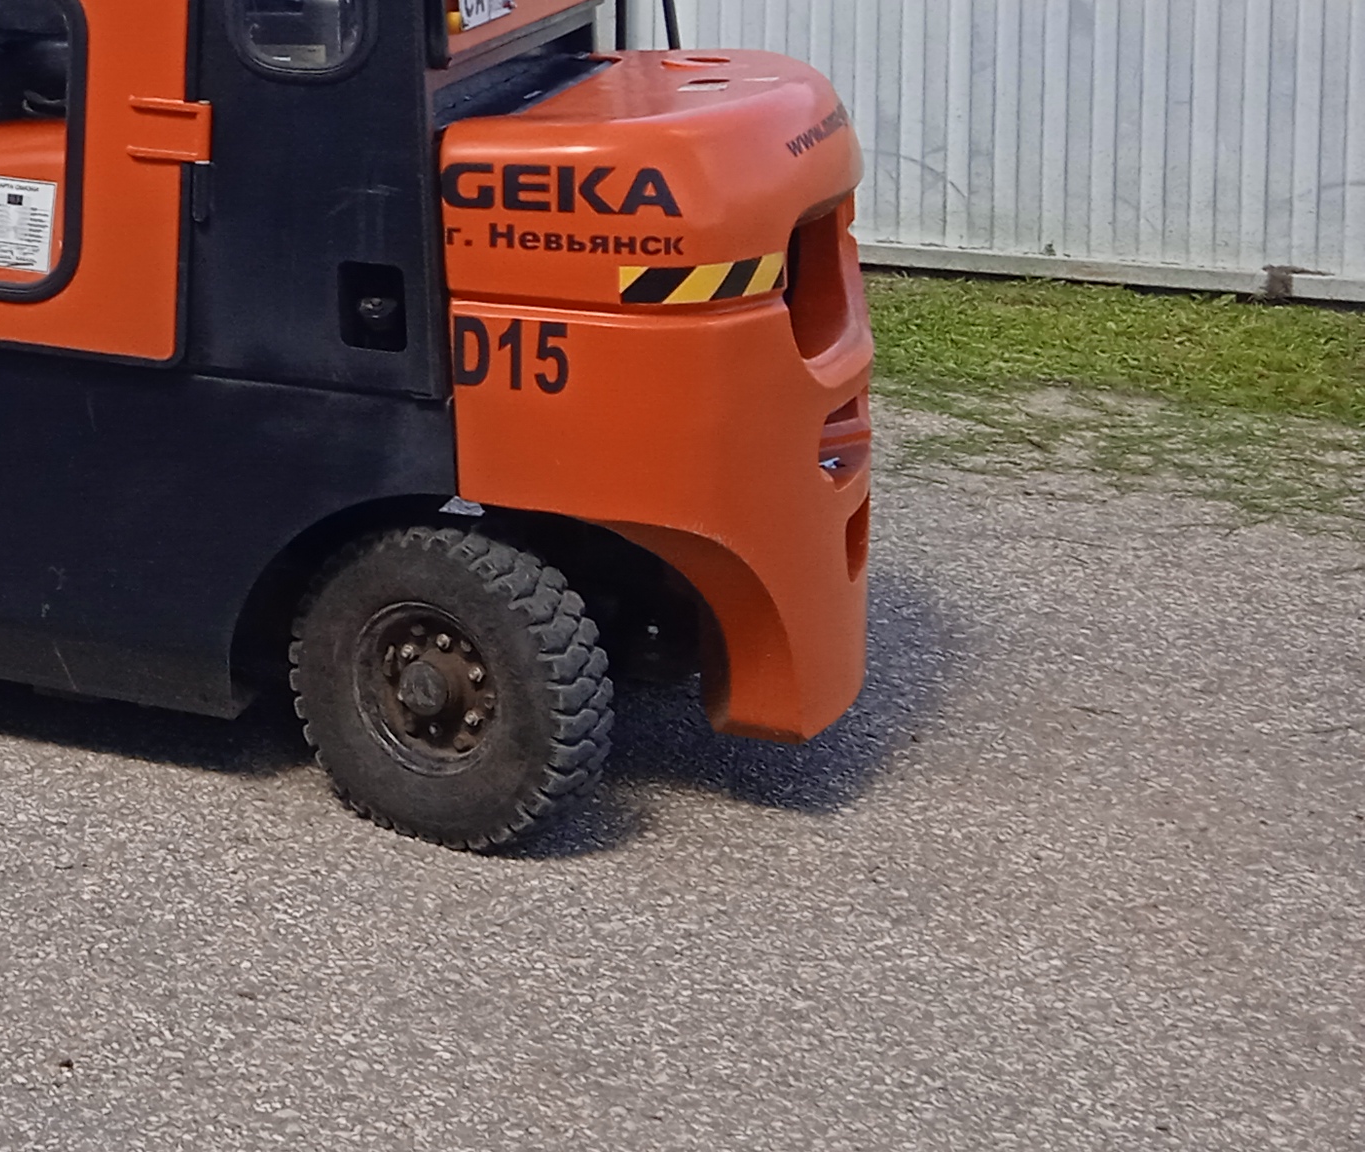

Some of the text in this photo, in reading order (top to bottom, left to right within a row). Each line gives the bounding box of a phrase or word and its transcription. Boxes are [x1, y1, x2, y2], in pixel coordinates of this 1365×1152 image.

[441, 162, 681, 217] GEKA
[446, 223, 685, 257] г. Невьянск
[453, 316, 569, 395] D15
